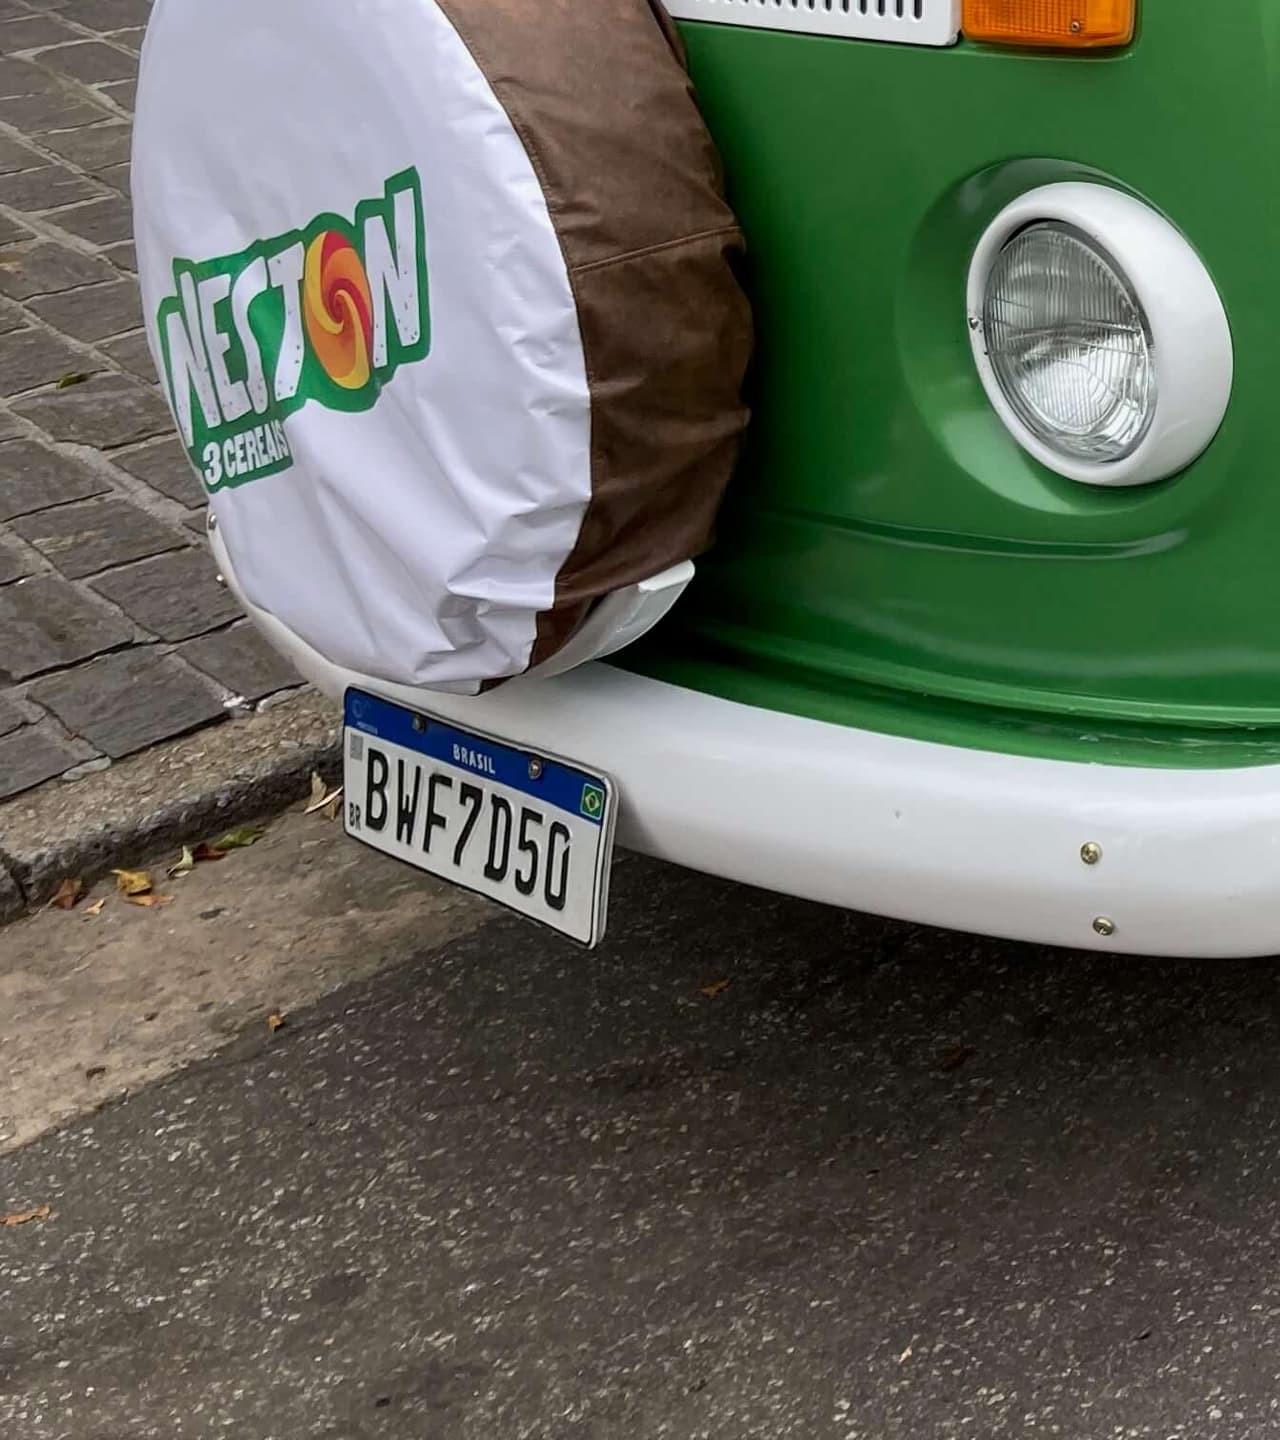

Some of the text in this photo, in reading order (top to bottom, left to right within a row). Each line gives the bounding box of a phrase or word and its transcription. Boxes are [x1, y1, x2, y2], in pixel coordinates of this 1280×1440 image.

[166, 188, 421, 447] NESTON
[203, 420, 289, 485] 3 CEREAIS
[452, 743, 496, 775] BRASIL
[365, 748, 572, 911] BWF7D50
